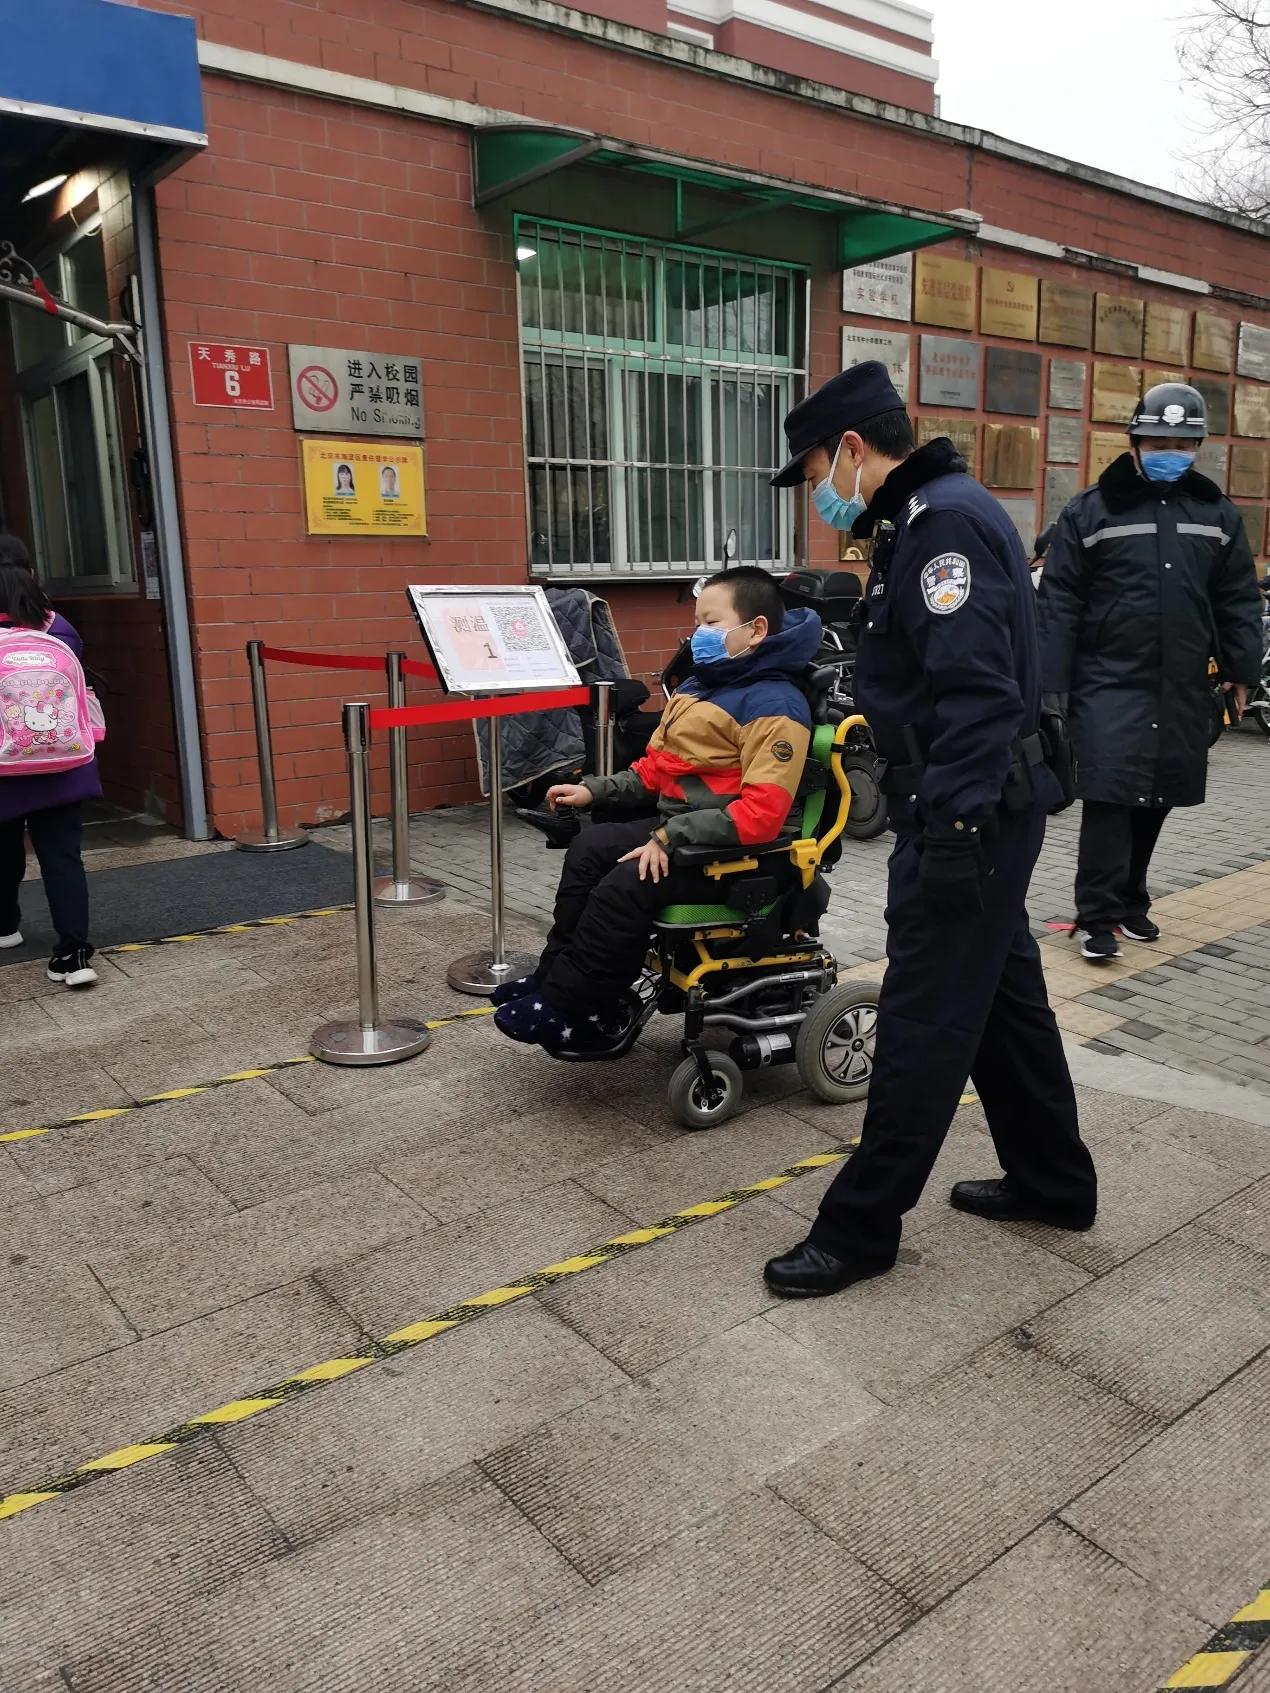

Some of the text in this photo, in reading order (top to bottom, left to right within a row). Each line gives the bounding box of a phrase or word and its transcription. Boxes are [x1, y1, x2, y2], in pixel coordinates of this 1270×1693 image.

[197, 346, 262, 366] 天秀路
[347, 359, 418, 385] 进入校园
[224, 370, 241, 397] 6
[349, 383, 420, 407] 严禁吸烟
[351, 406, 367, 422] No
[483, 642, 499, 659] 1
